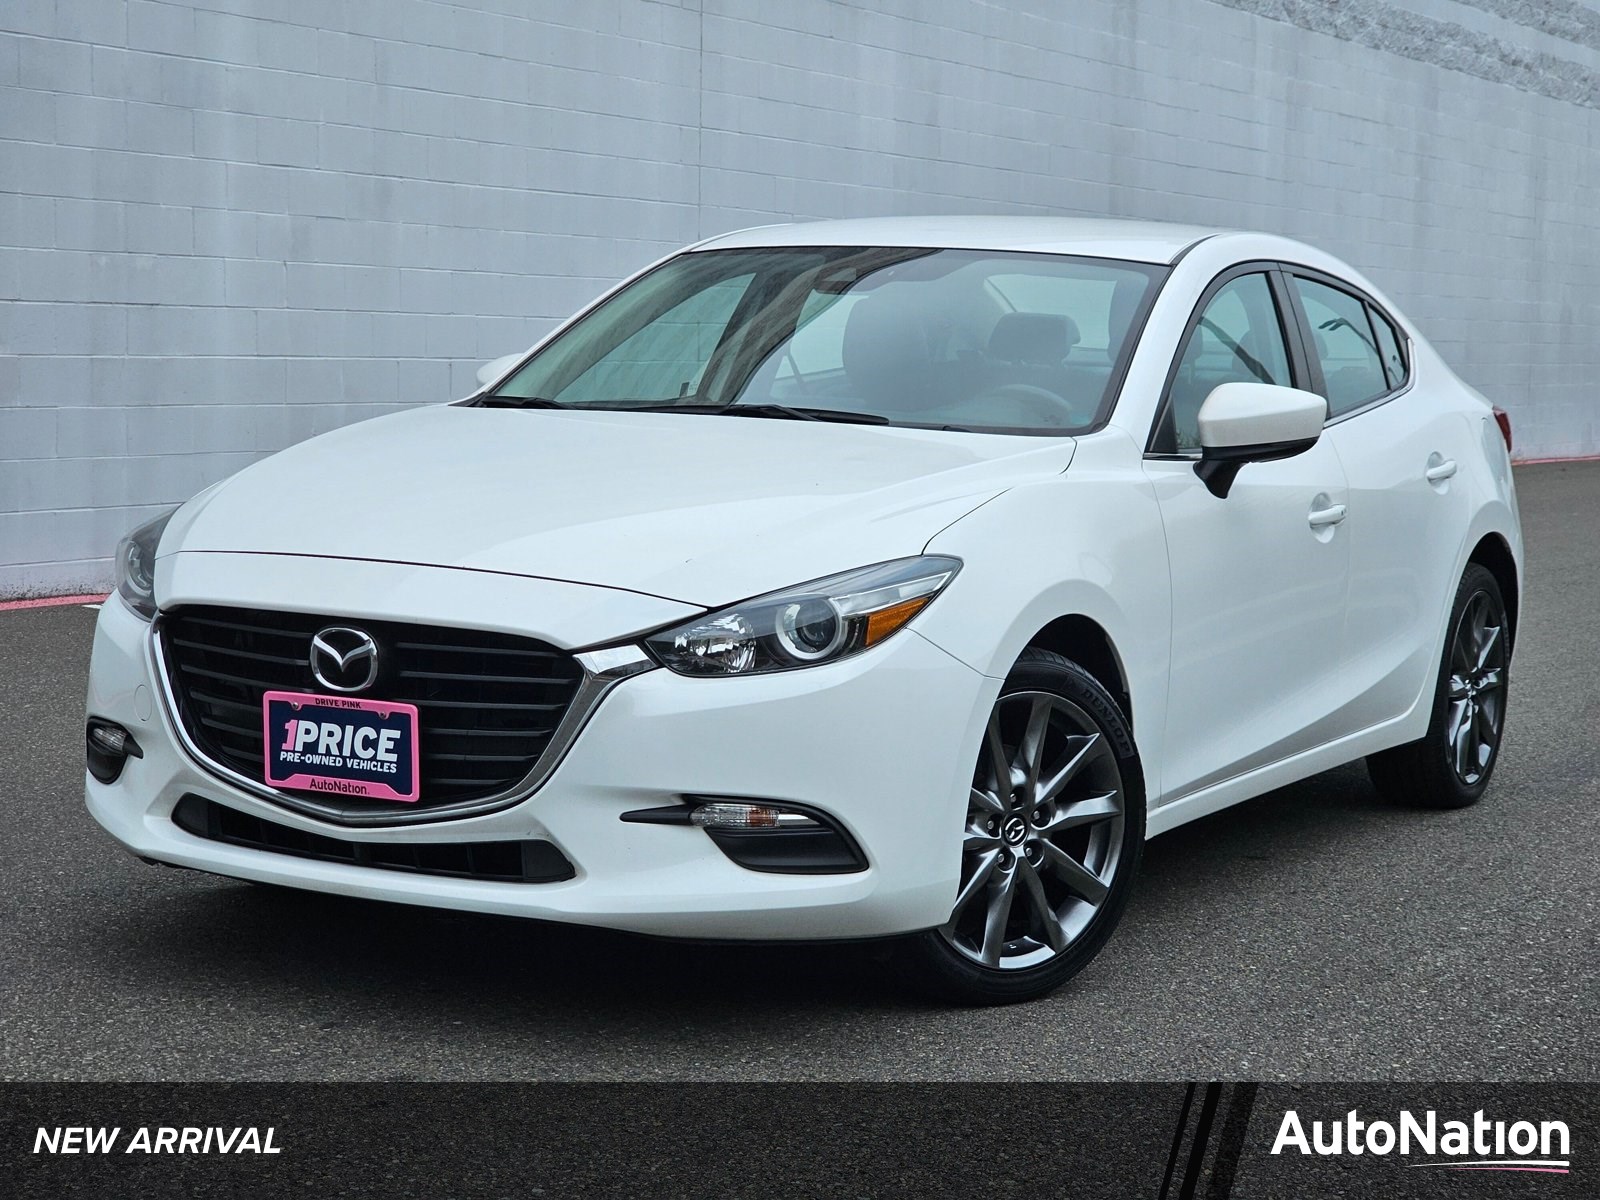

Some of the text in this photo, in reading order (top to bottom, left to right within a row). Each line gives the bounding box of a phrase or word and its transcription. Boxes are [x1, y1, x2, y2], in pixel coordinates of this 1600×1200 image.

[315, 698, 362, 709] DRIVE PINK
[1081, 688, 1131, 752] DUNLOP
[282, 719, 401, 762] 1PRICE
[280, 751, 397, 774] PRE-OWNED VEHICLES
